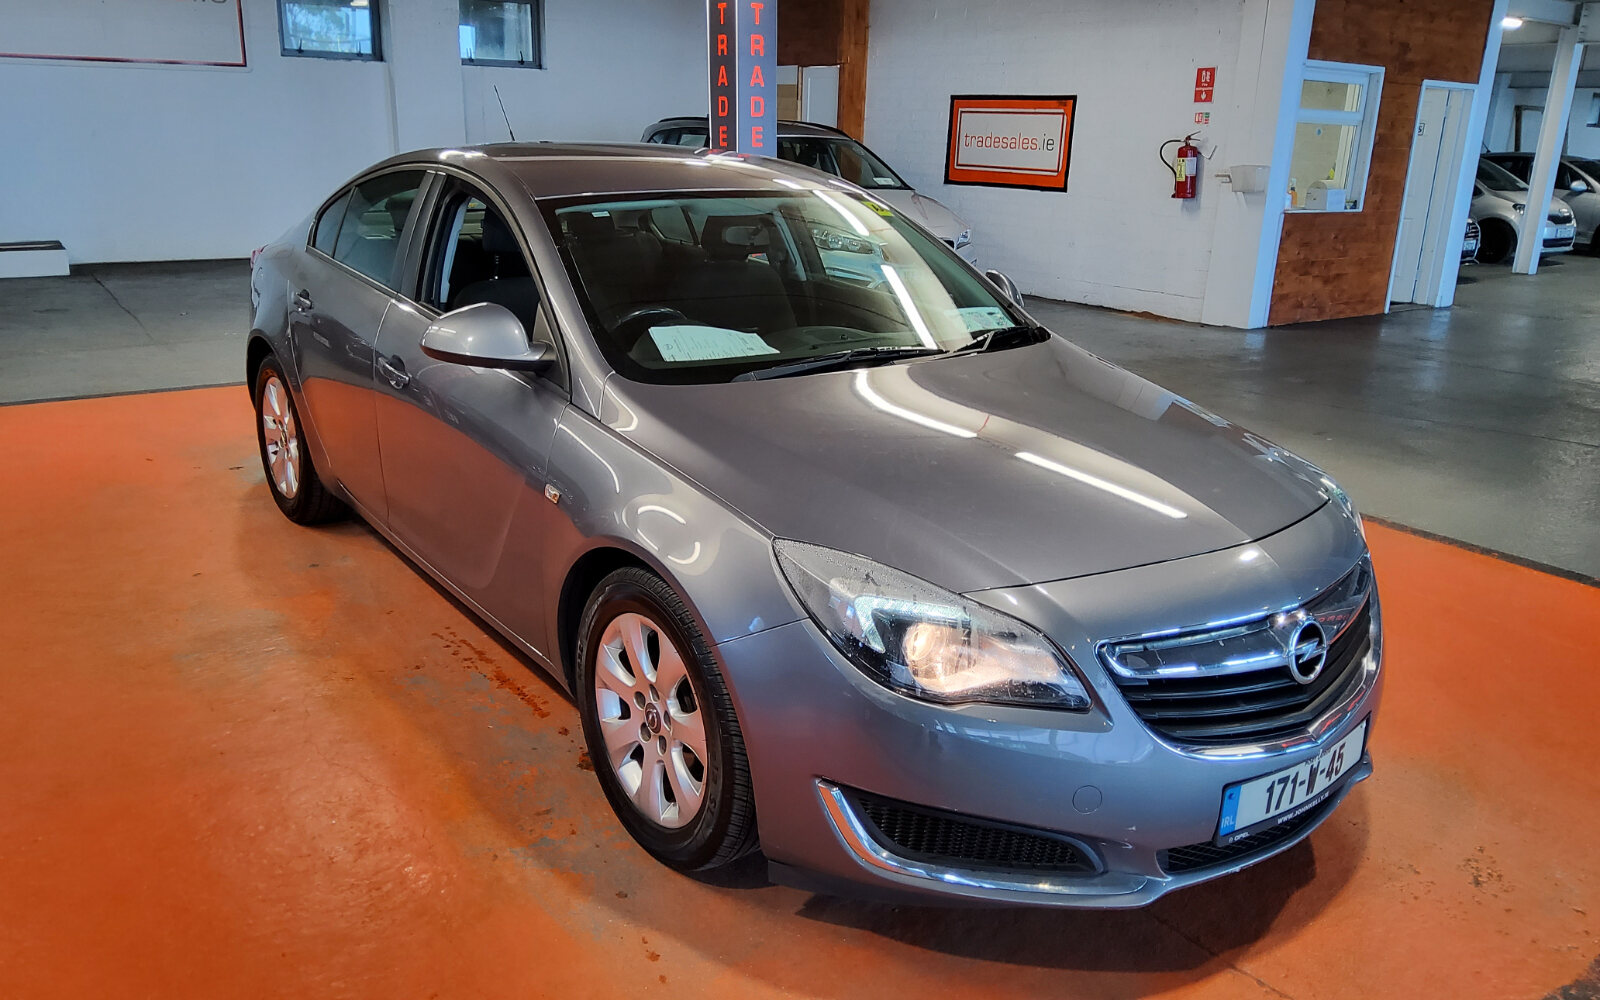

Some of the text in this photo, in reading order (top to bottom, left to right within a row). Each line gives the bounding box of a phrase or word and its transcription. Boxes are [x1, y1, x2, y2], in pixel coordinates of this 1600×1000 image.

[717, 3, 729, 147] TRADE
[750, 3, 765, 147] TRADE
[964, 131, 1055, 152] tradesales.ie
[1265, 743, 1346, 815] 171-W-45
[1221, 816, 1235, 829] IRL
